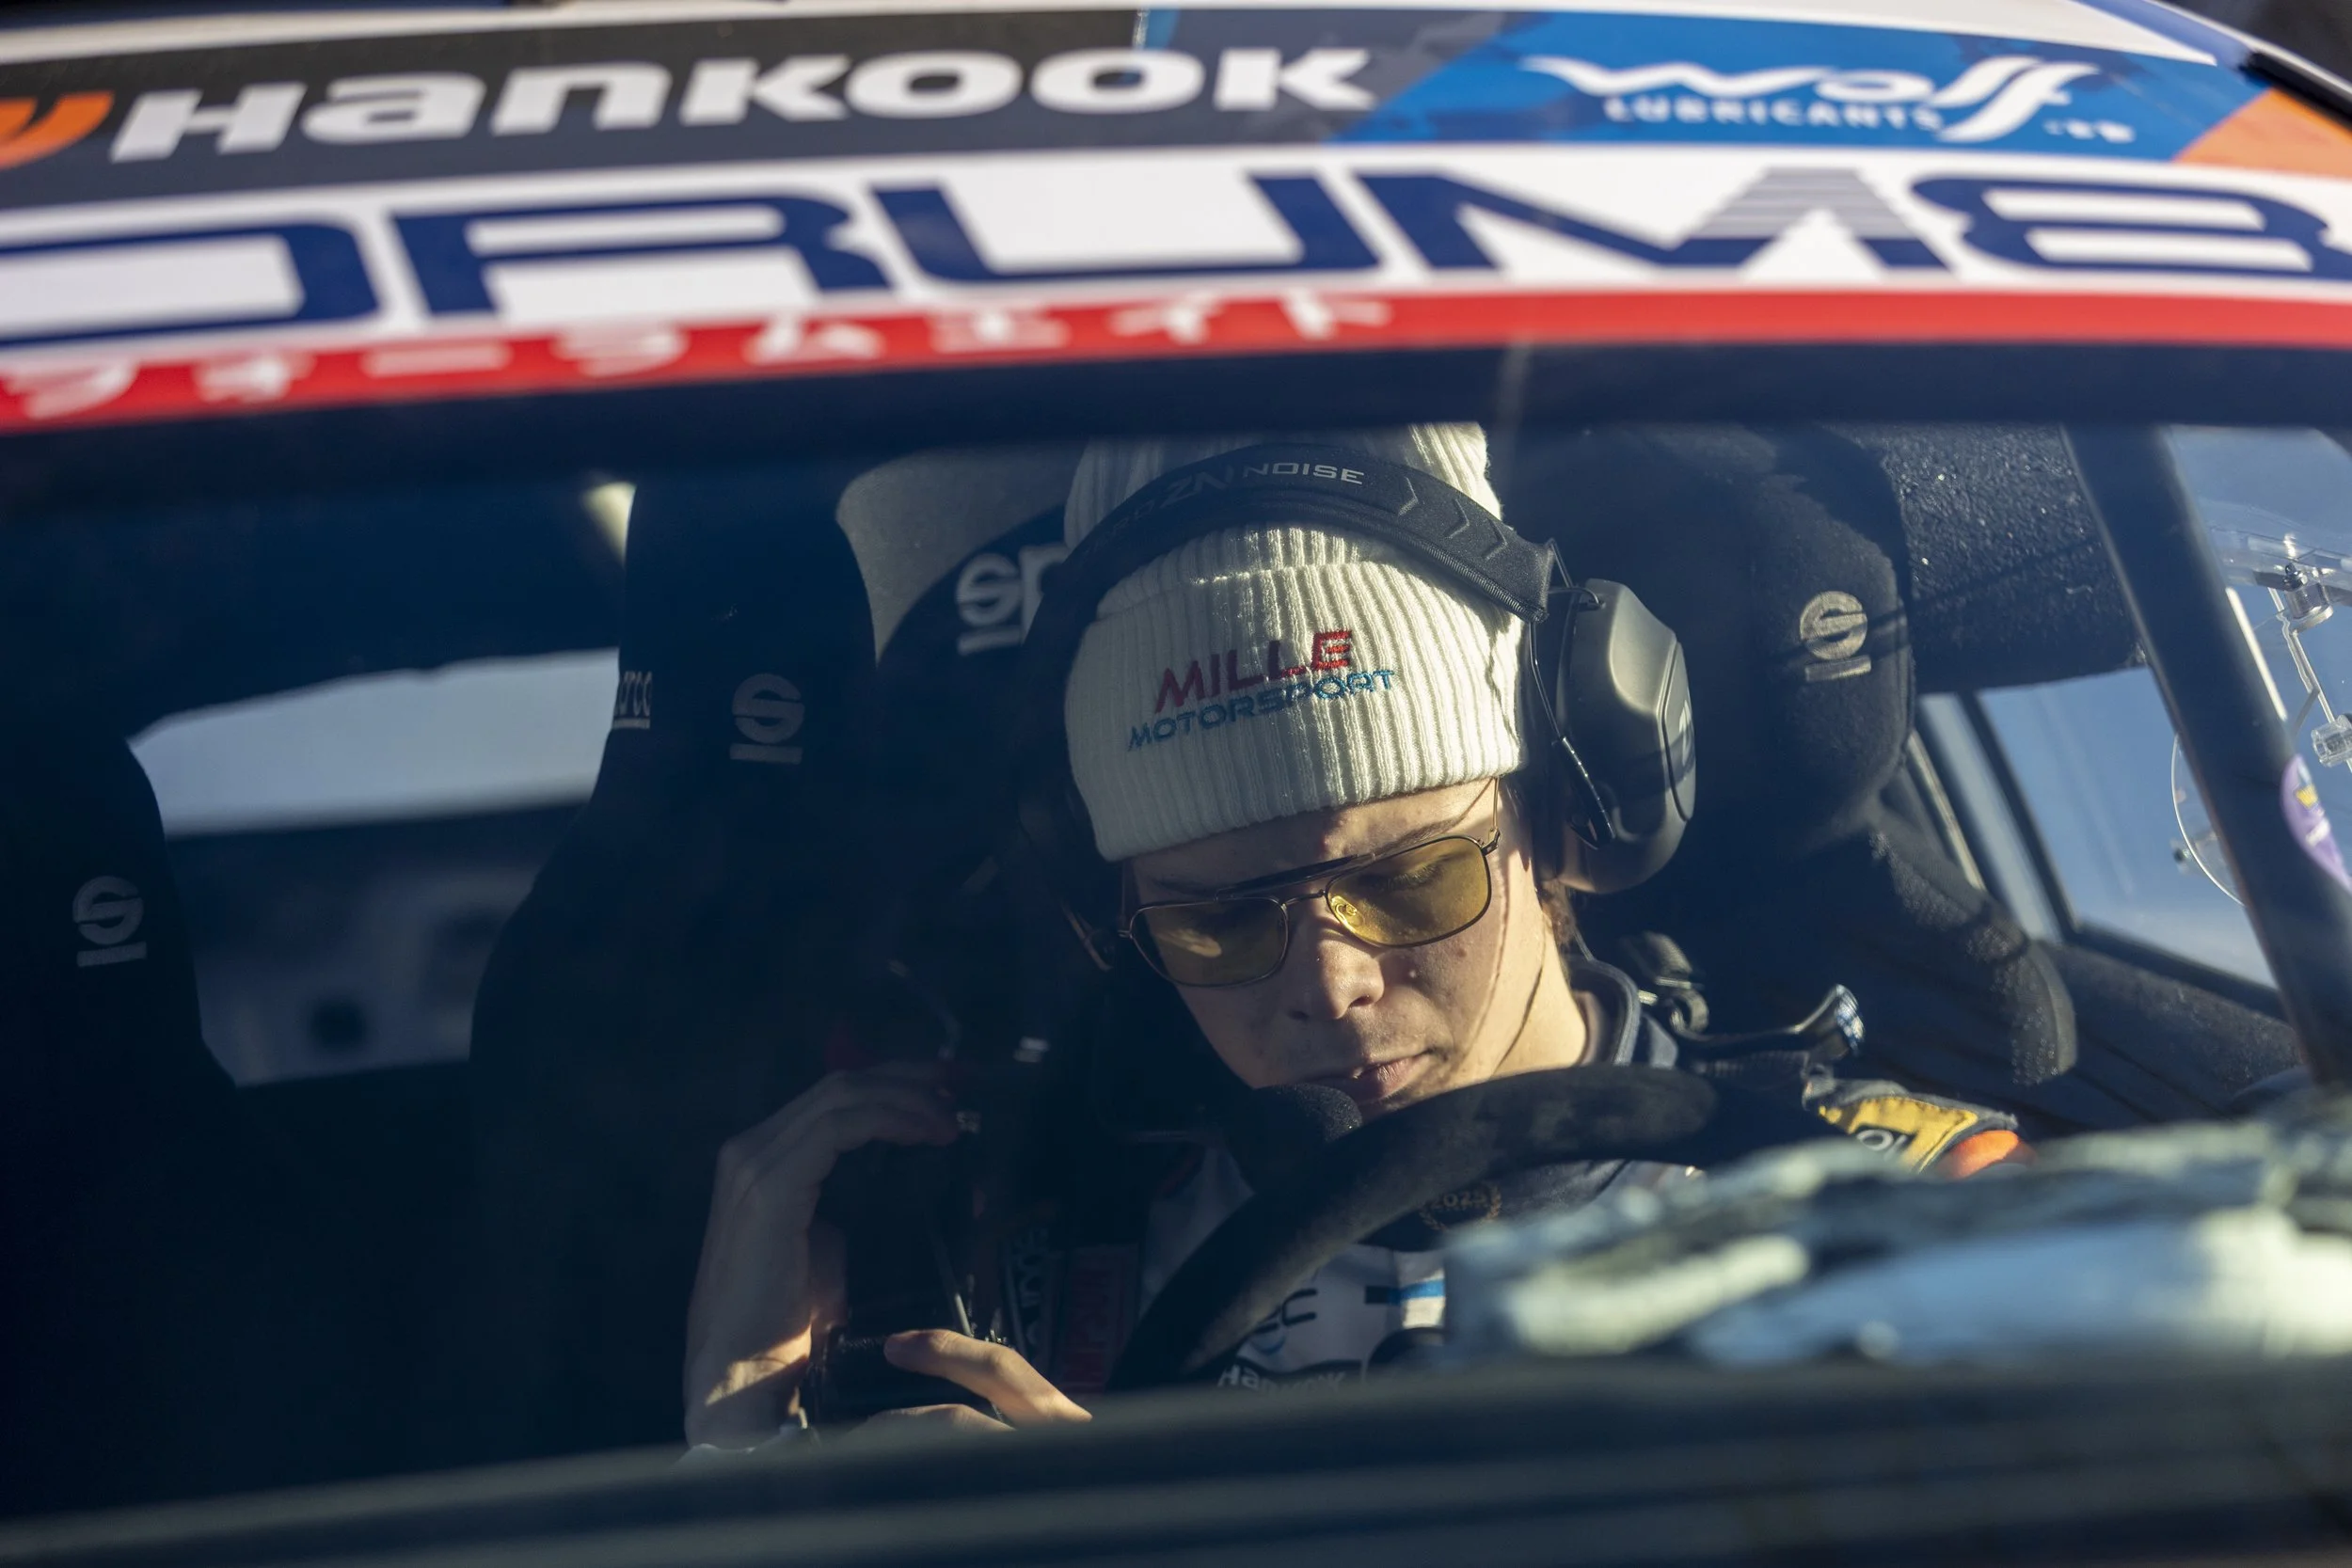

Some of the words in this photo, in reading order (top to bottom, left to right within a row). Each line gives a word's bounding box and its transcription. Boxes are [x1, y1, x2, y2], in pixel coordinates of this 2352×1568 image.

[1603, 95, 1945, 132] LUBRICANTS
[1243, 462, 1364, 485] NOISE
[1153, 629, 1353, 714] MILLE
[1128, 669, 1394, 752] MOTORSPORT
